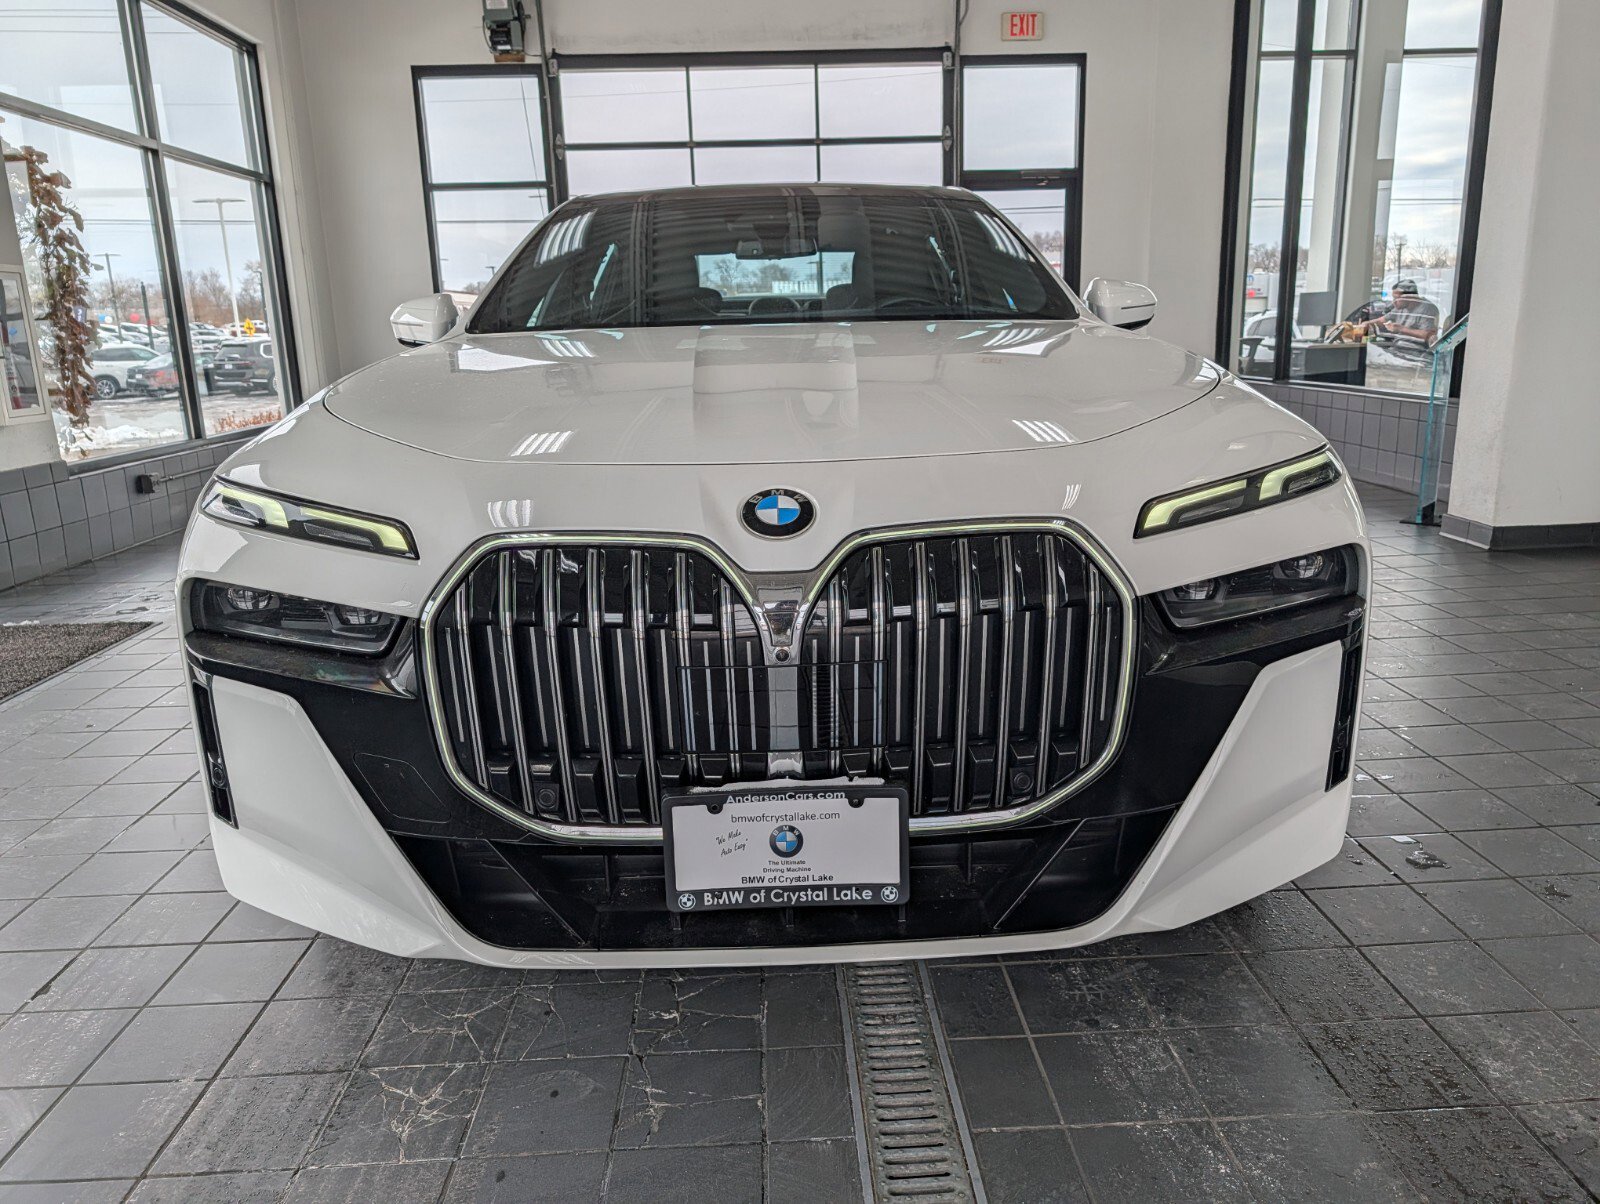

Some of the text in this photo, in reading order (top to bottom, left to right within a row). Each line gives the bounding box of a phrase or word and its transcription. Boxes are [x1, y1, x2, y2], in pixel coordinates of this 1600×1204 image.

[1010, 13, 1038, 37] EXIT
[725, 791, 846, 804] AndersonCars.com
[730, 811, 841, 824] bmwofcrystallake.com
[741, 874, 834, 885] BMW of Crystal Lake
[703, 886, 873, 906] BMW of Crystal Lake
